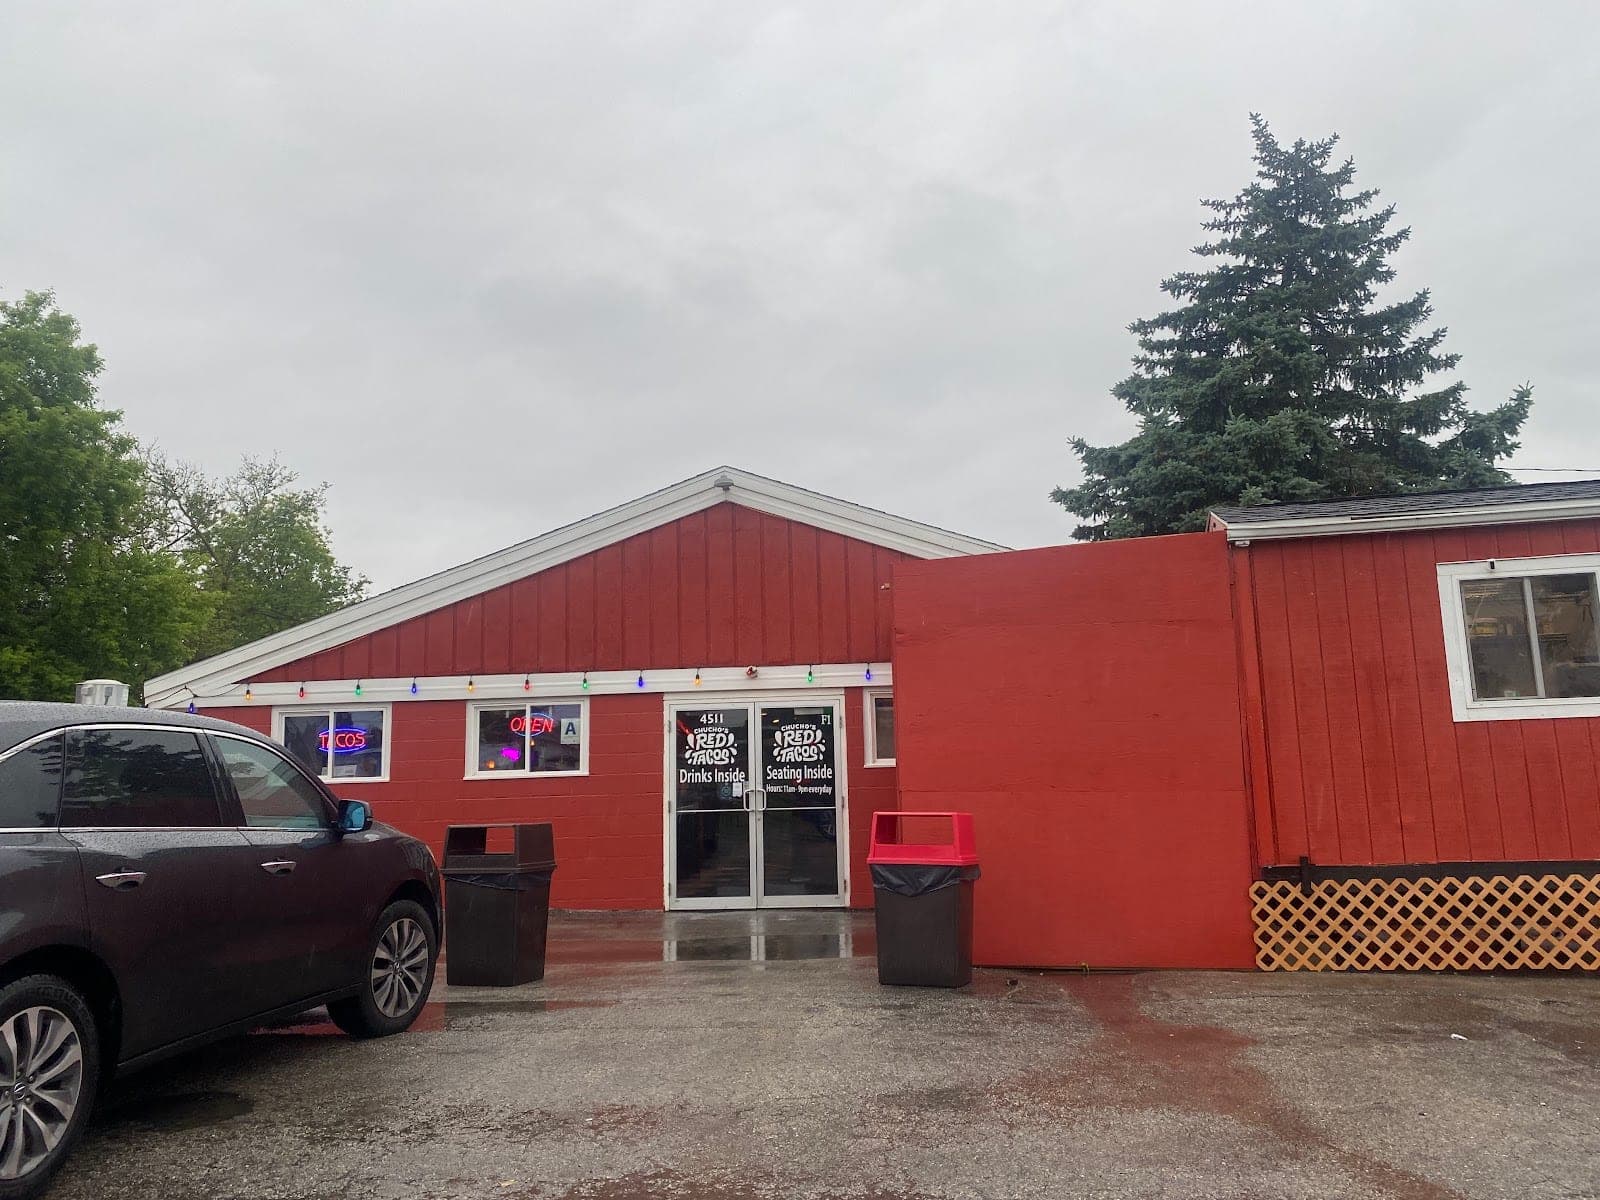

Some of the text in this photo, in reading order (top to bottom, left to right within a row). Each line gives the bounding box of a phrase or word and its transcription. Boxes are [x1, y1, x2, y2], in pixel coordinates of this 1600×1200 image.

[700, 713, 724, 724] 4511
[565, 722, 576, 735] A
[693, 726, 729, 734] CHUCHO'S
[781, 723, 816, 732] CHUCHO'S
[318, 733, 365, 749] TCOS
[695, 733, 727, 751] RED
[783, 730, 814, 748] RED
[691, 748, 730, 766] TACOS
[780, 745, 818, 763] TACOS
[679, 767, 745, 784] Drinks Inside
[766, 764, 833, 784] Seating Inside
[808, 784, 833, 795] everyday
